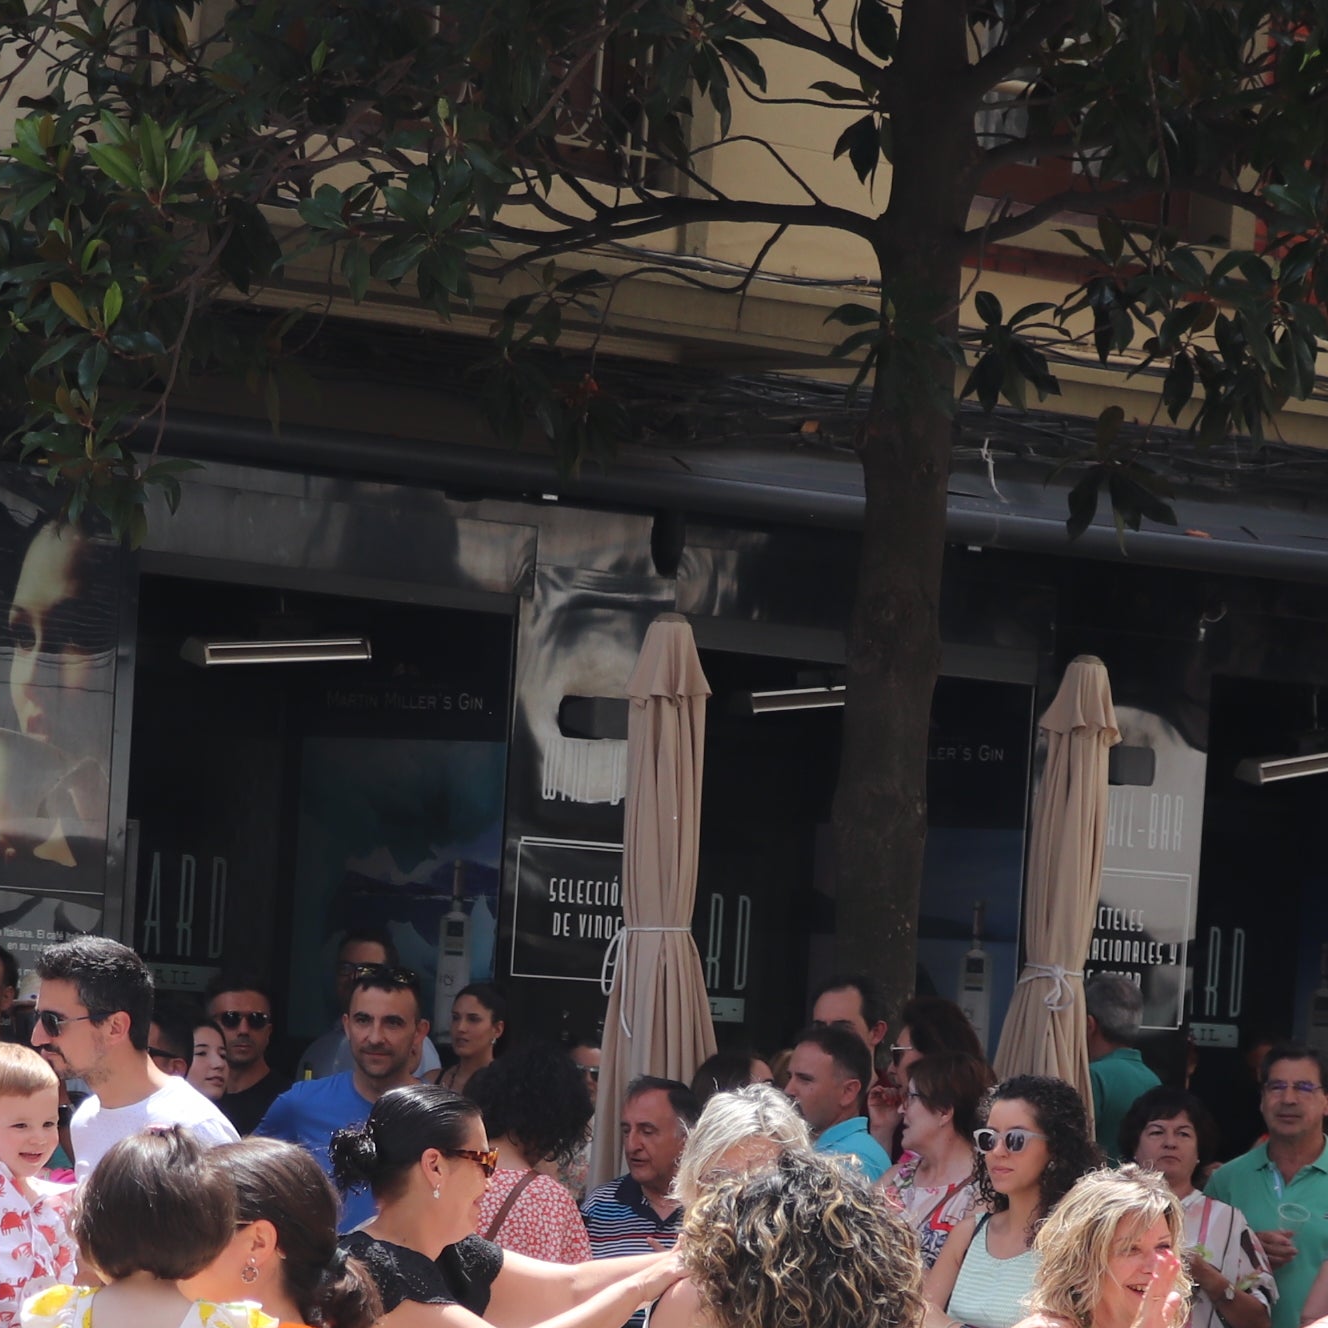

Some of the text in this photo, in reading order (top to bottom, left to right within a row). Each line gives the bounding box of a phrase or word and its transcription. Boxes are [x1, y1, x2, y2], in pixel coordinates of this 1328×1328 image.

[549, 875, 623, 906] SELECCIÓ
[553, 912, 571, 937] DE
[1093, 906, 1144, 933] CTELES
